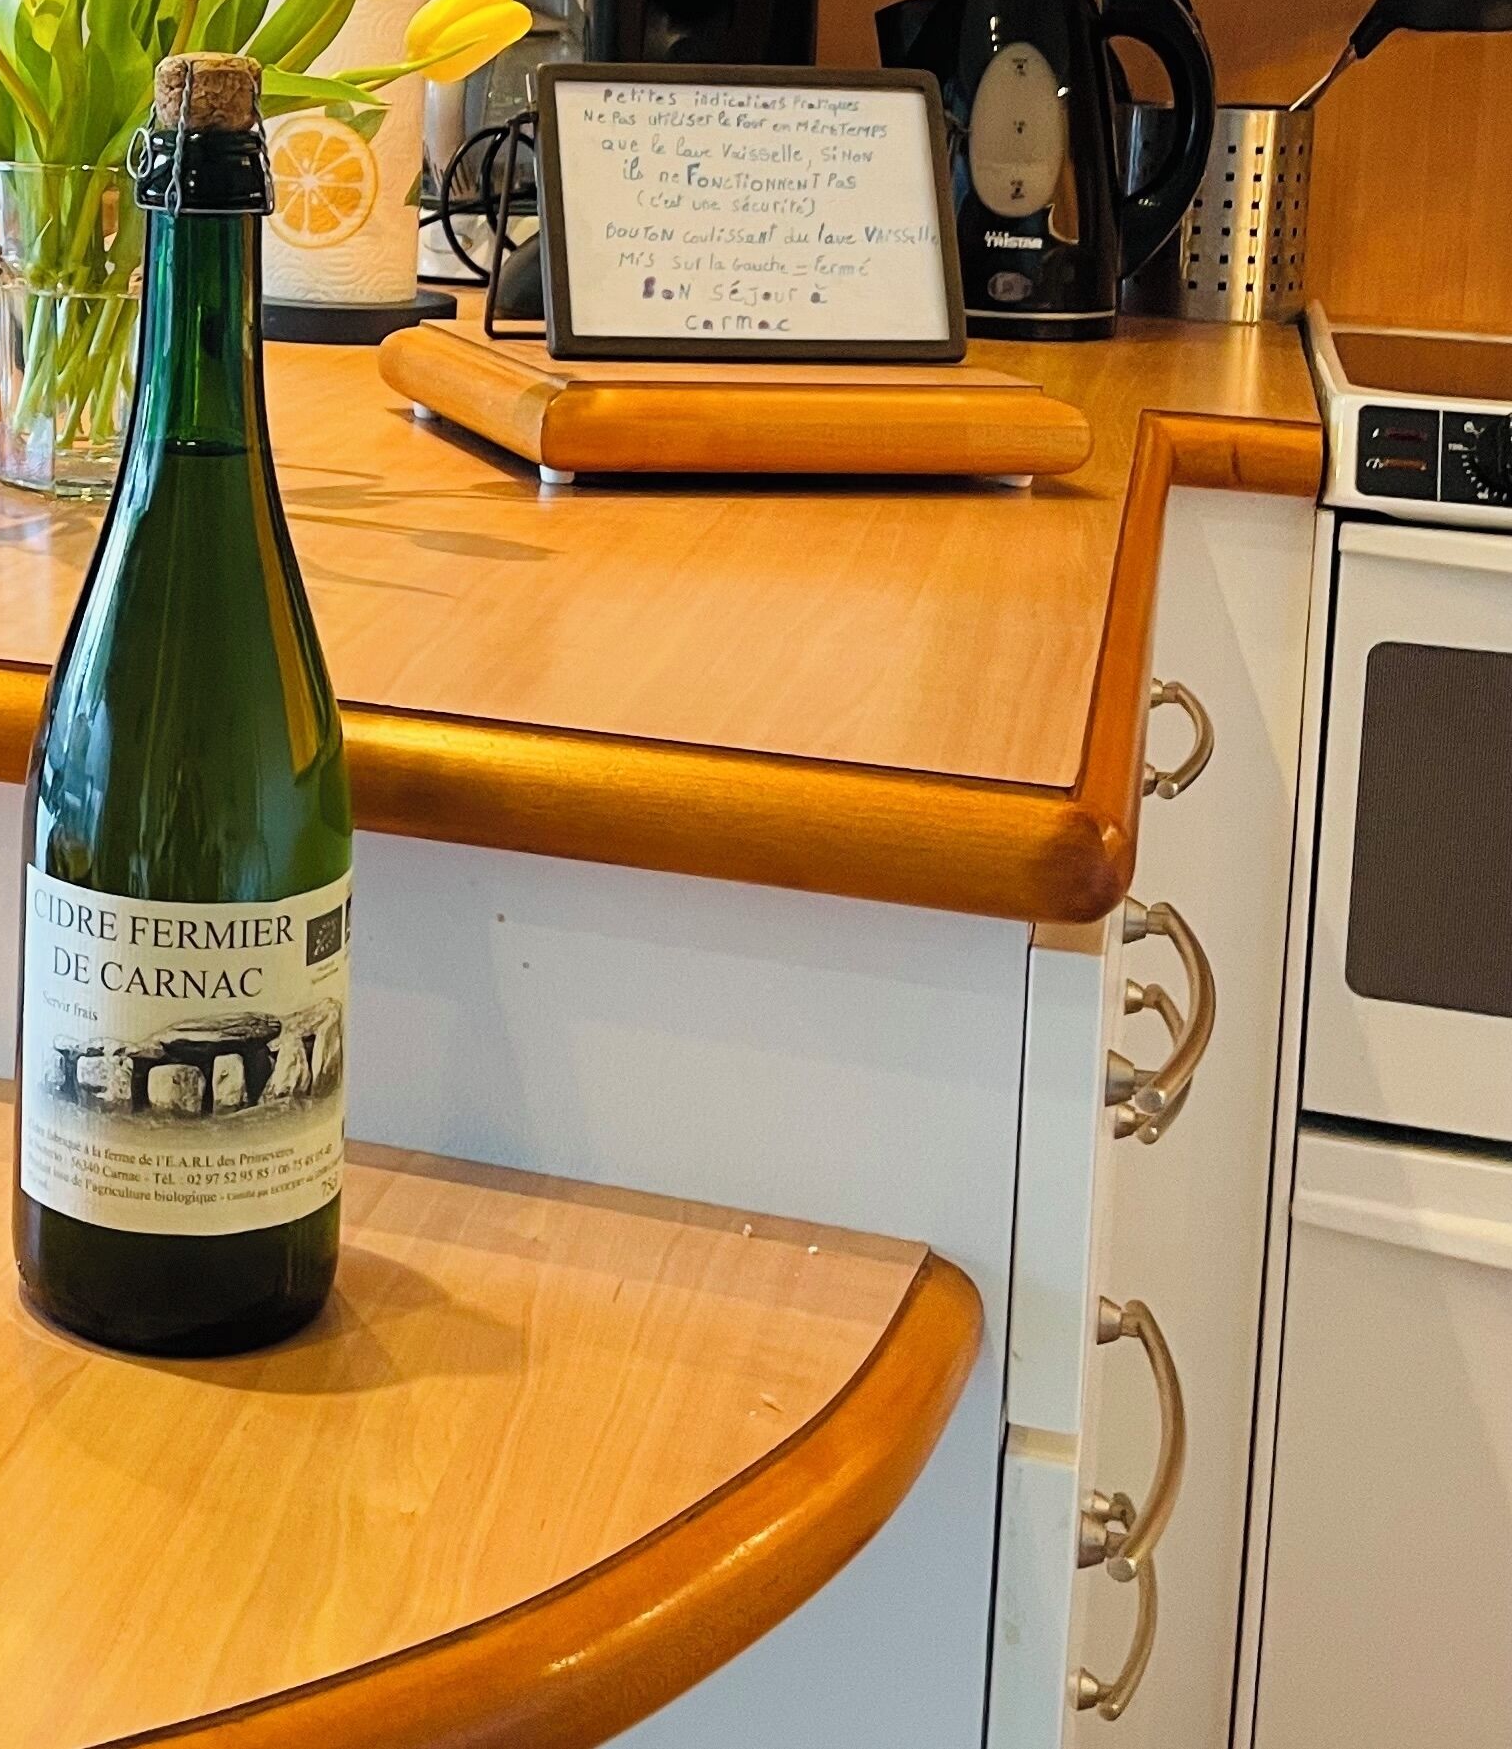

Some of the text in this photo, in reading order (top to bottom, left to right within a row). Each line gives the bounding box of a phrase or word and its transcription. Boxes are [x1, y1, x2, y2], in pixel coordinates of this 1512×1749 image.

[651, 133, 666, 154] le
[659, 171, 679, 183] ne
[692, 199, 721, 211] une
[784, 226, 809, 244] du
[709, 253, 726, 270] la
[34, 889, 295, 950] CIDRE FERMIER
[53, 945, 263, 999] DE CARNAC
[73, 1003, 98, 1021] frais
[104, 1147, 136, 1165] ferme
[139, 1151, 152, 1166] de
[217, 1154, 236, 1167] des
[102, 1164, 141, 1183] Carnac
[186, 1172, 202, 1185] 02
[205, 1171, 219, 1184] 97
[224, 1170, 237, 1184] 52
[154, 1189, 218, 1206] biologique
